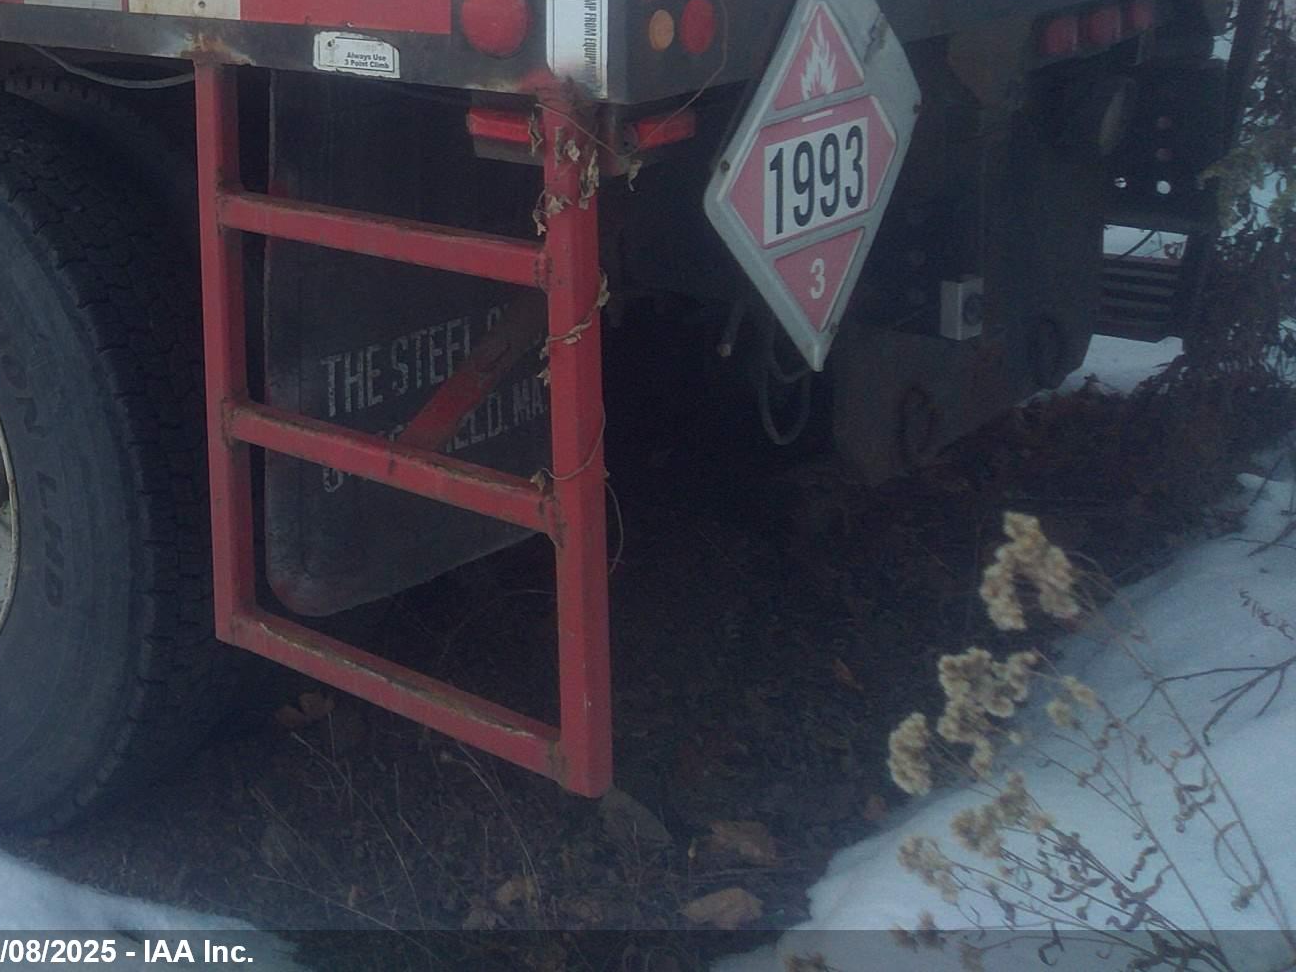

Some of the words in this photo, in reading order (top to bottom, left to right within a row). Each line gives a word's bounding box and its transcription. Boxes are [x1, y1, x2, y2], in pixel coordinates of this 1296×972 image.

[584, 12, 597, 37] FROM
[346, 51, 371, 61] Always
[370, 61, 390, 69] Climb
[769, 125, 864, 235] 1993
[810, 258, 825, 300] 3
[319, 344, 383, 417] THE
